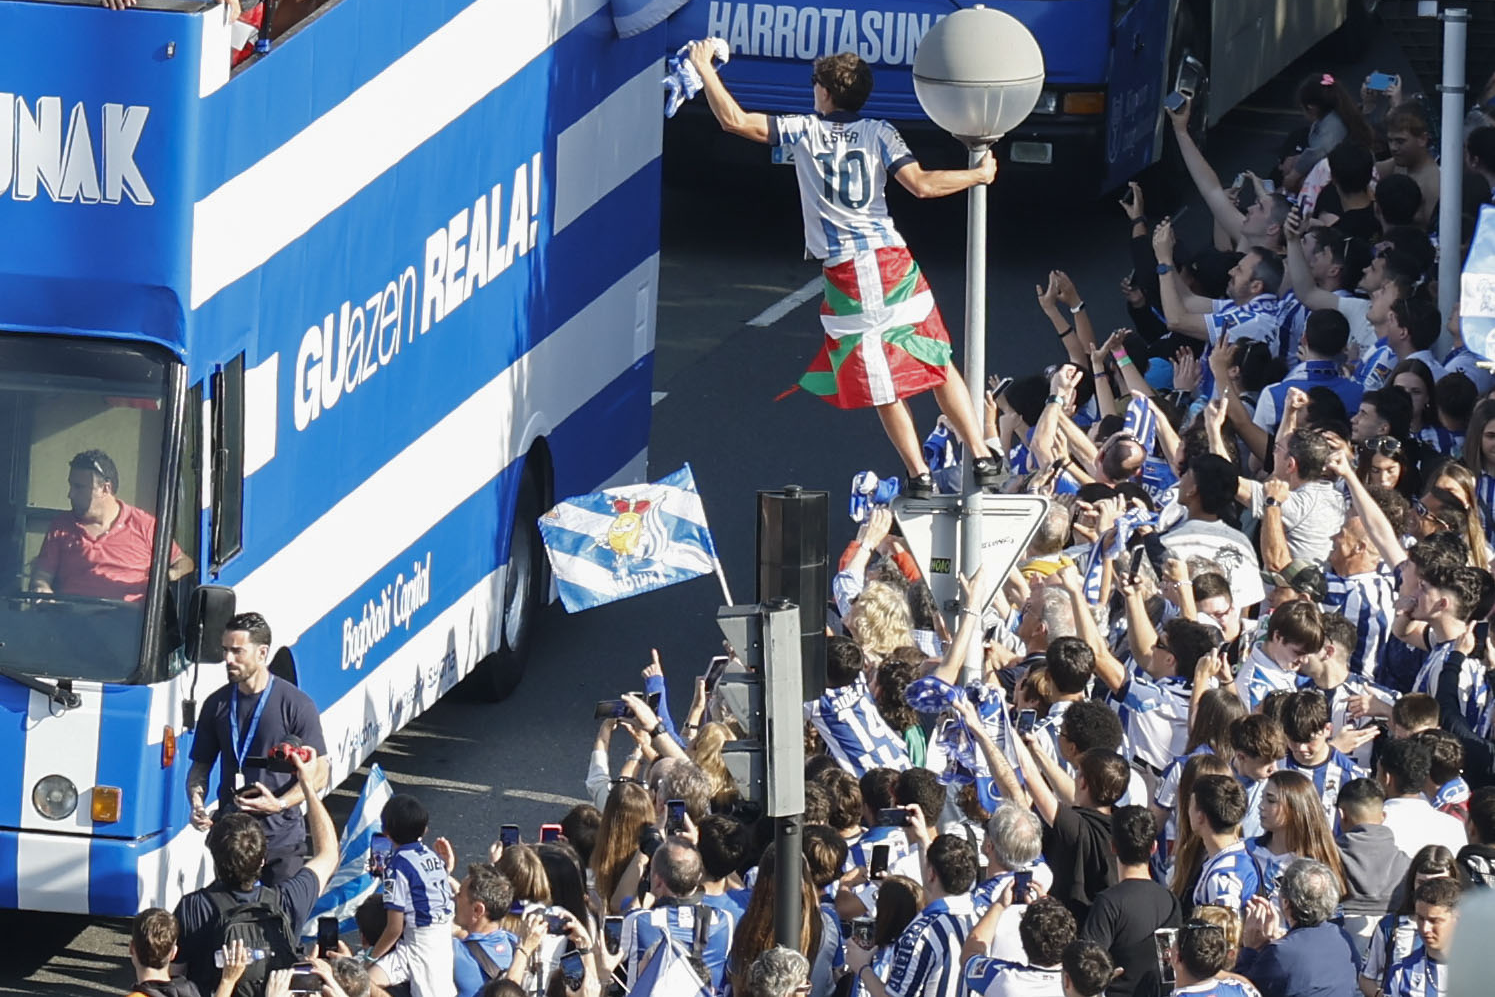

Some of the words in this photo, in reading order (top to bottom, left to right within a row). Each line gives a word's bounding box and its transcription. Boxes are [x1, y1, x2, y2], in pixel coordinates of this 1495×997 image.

[708, 1, 942, 66] HARROTASUN
[814, 149, 871, 210] 10
[293, 265, 416, 432] GUazen
[420, 152, 542, 335] REALA!
[393, 551, 432, 631] Capital
